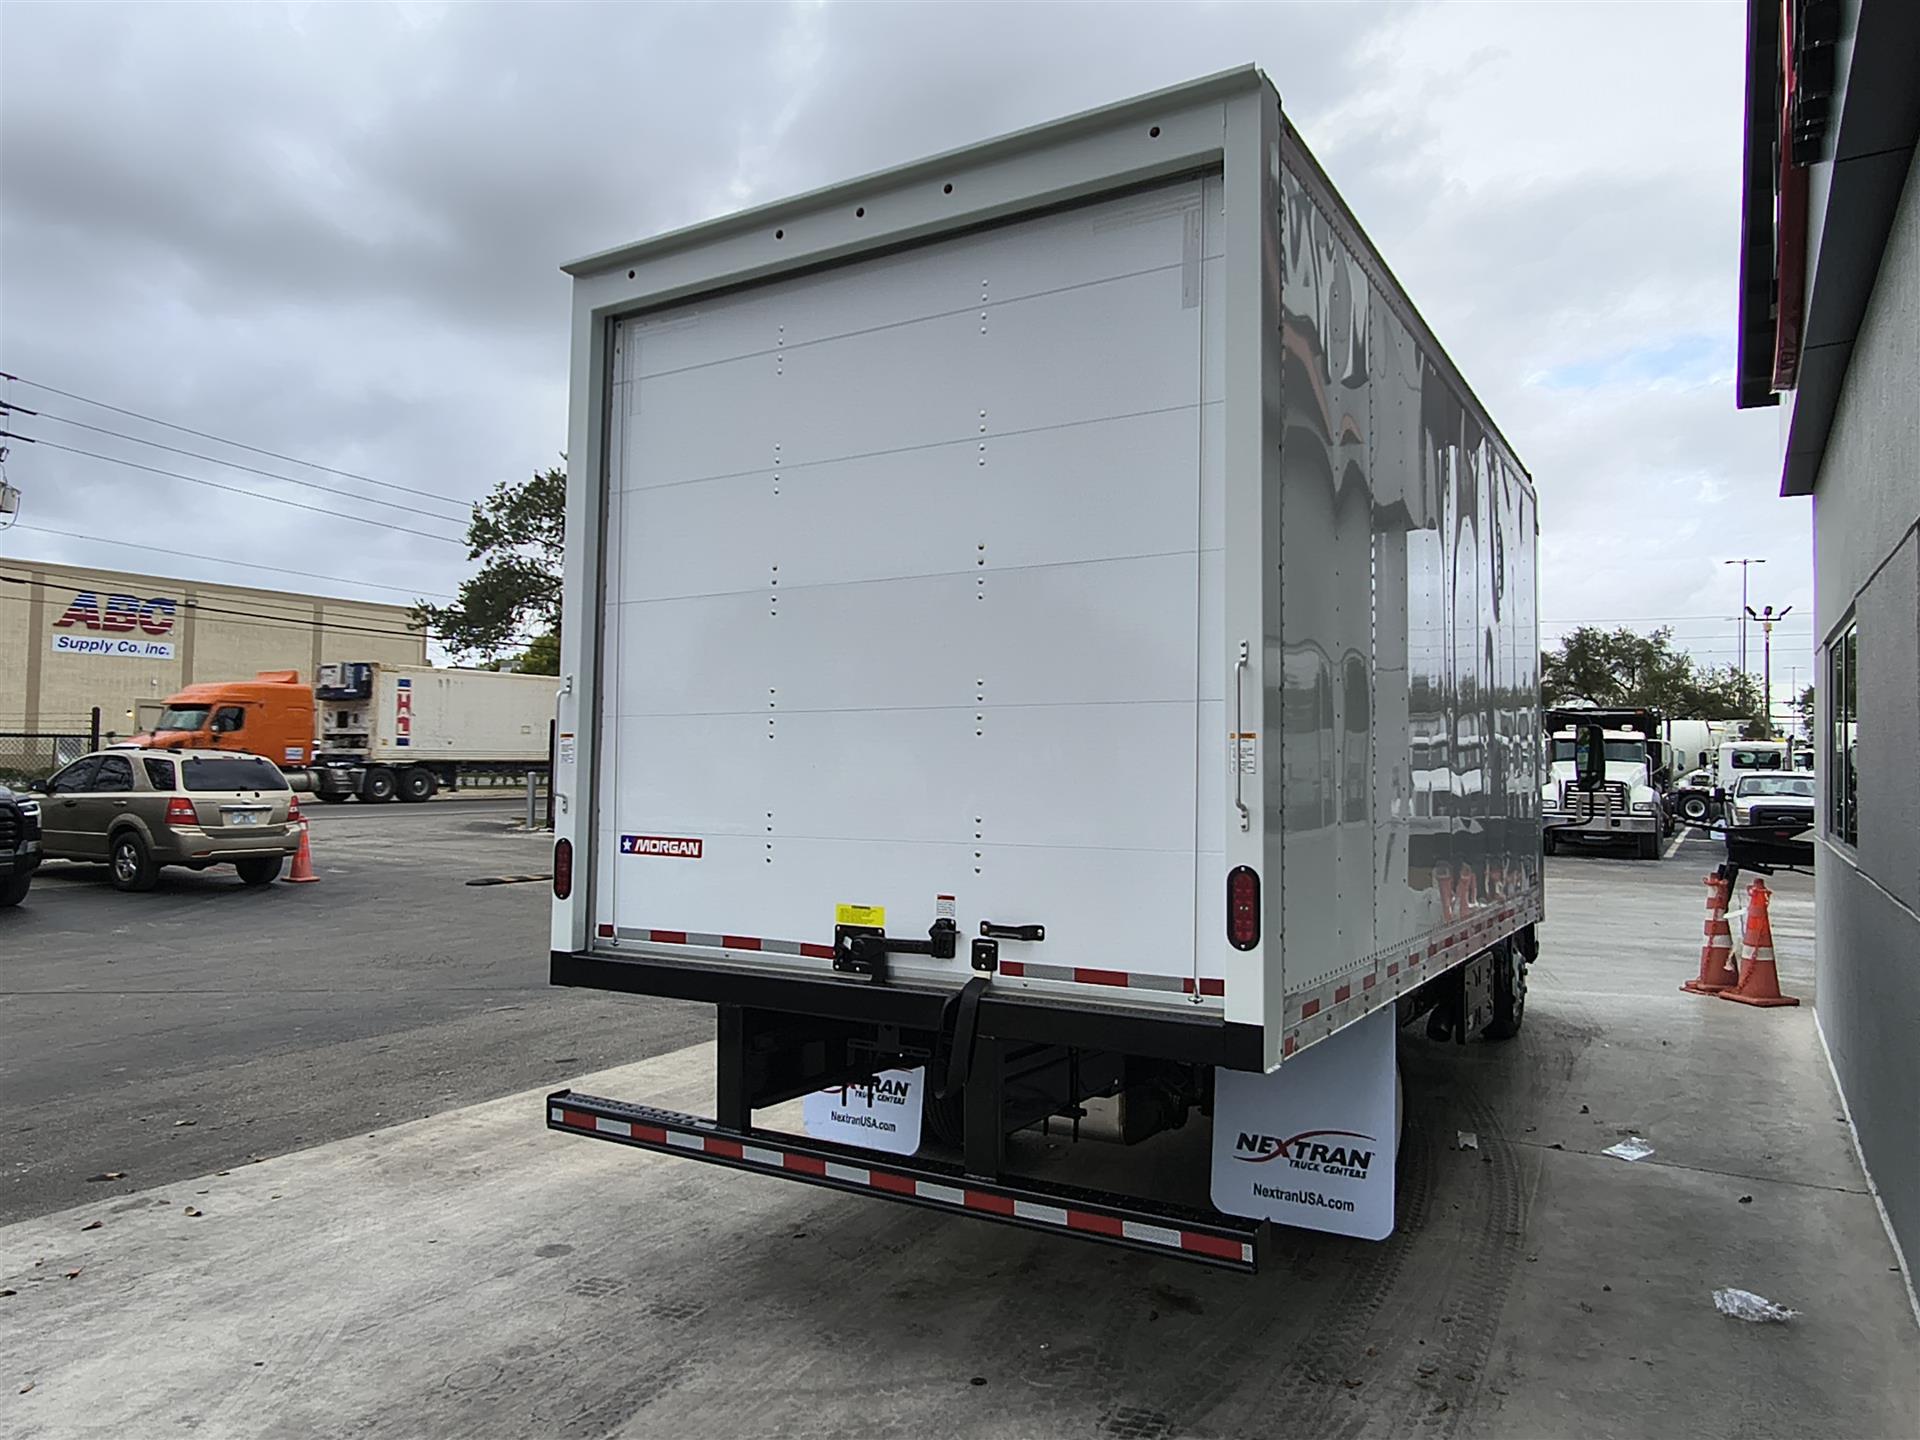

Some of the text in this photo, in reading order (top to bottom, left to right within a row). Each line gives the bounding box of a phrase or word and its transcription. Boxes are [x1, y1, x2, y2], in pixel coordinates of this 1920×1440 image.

[53, 591, 177, 635] ABC
[57, 636, 113, 653] Supply
[117, 641, 141, 653] Co.
[634, 839, 700, 855] MORGAN
[855, 1090, 876, 1100] TRUK
[830, 1110, 896, 1132] NextranUSA.com
[1236, 1132, 1372, 1169] NEXTRAN
[1288, 1159, 1367, 1180] TRUCK CENTERS
[1253, 1182, 1354, 1212] NextranUSA.com
